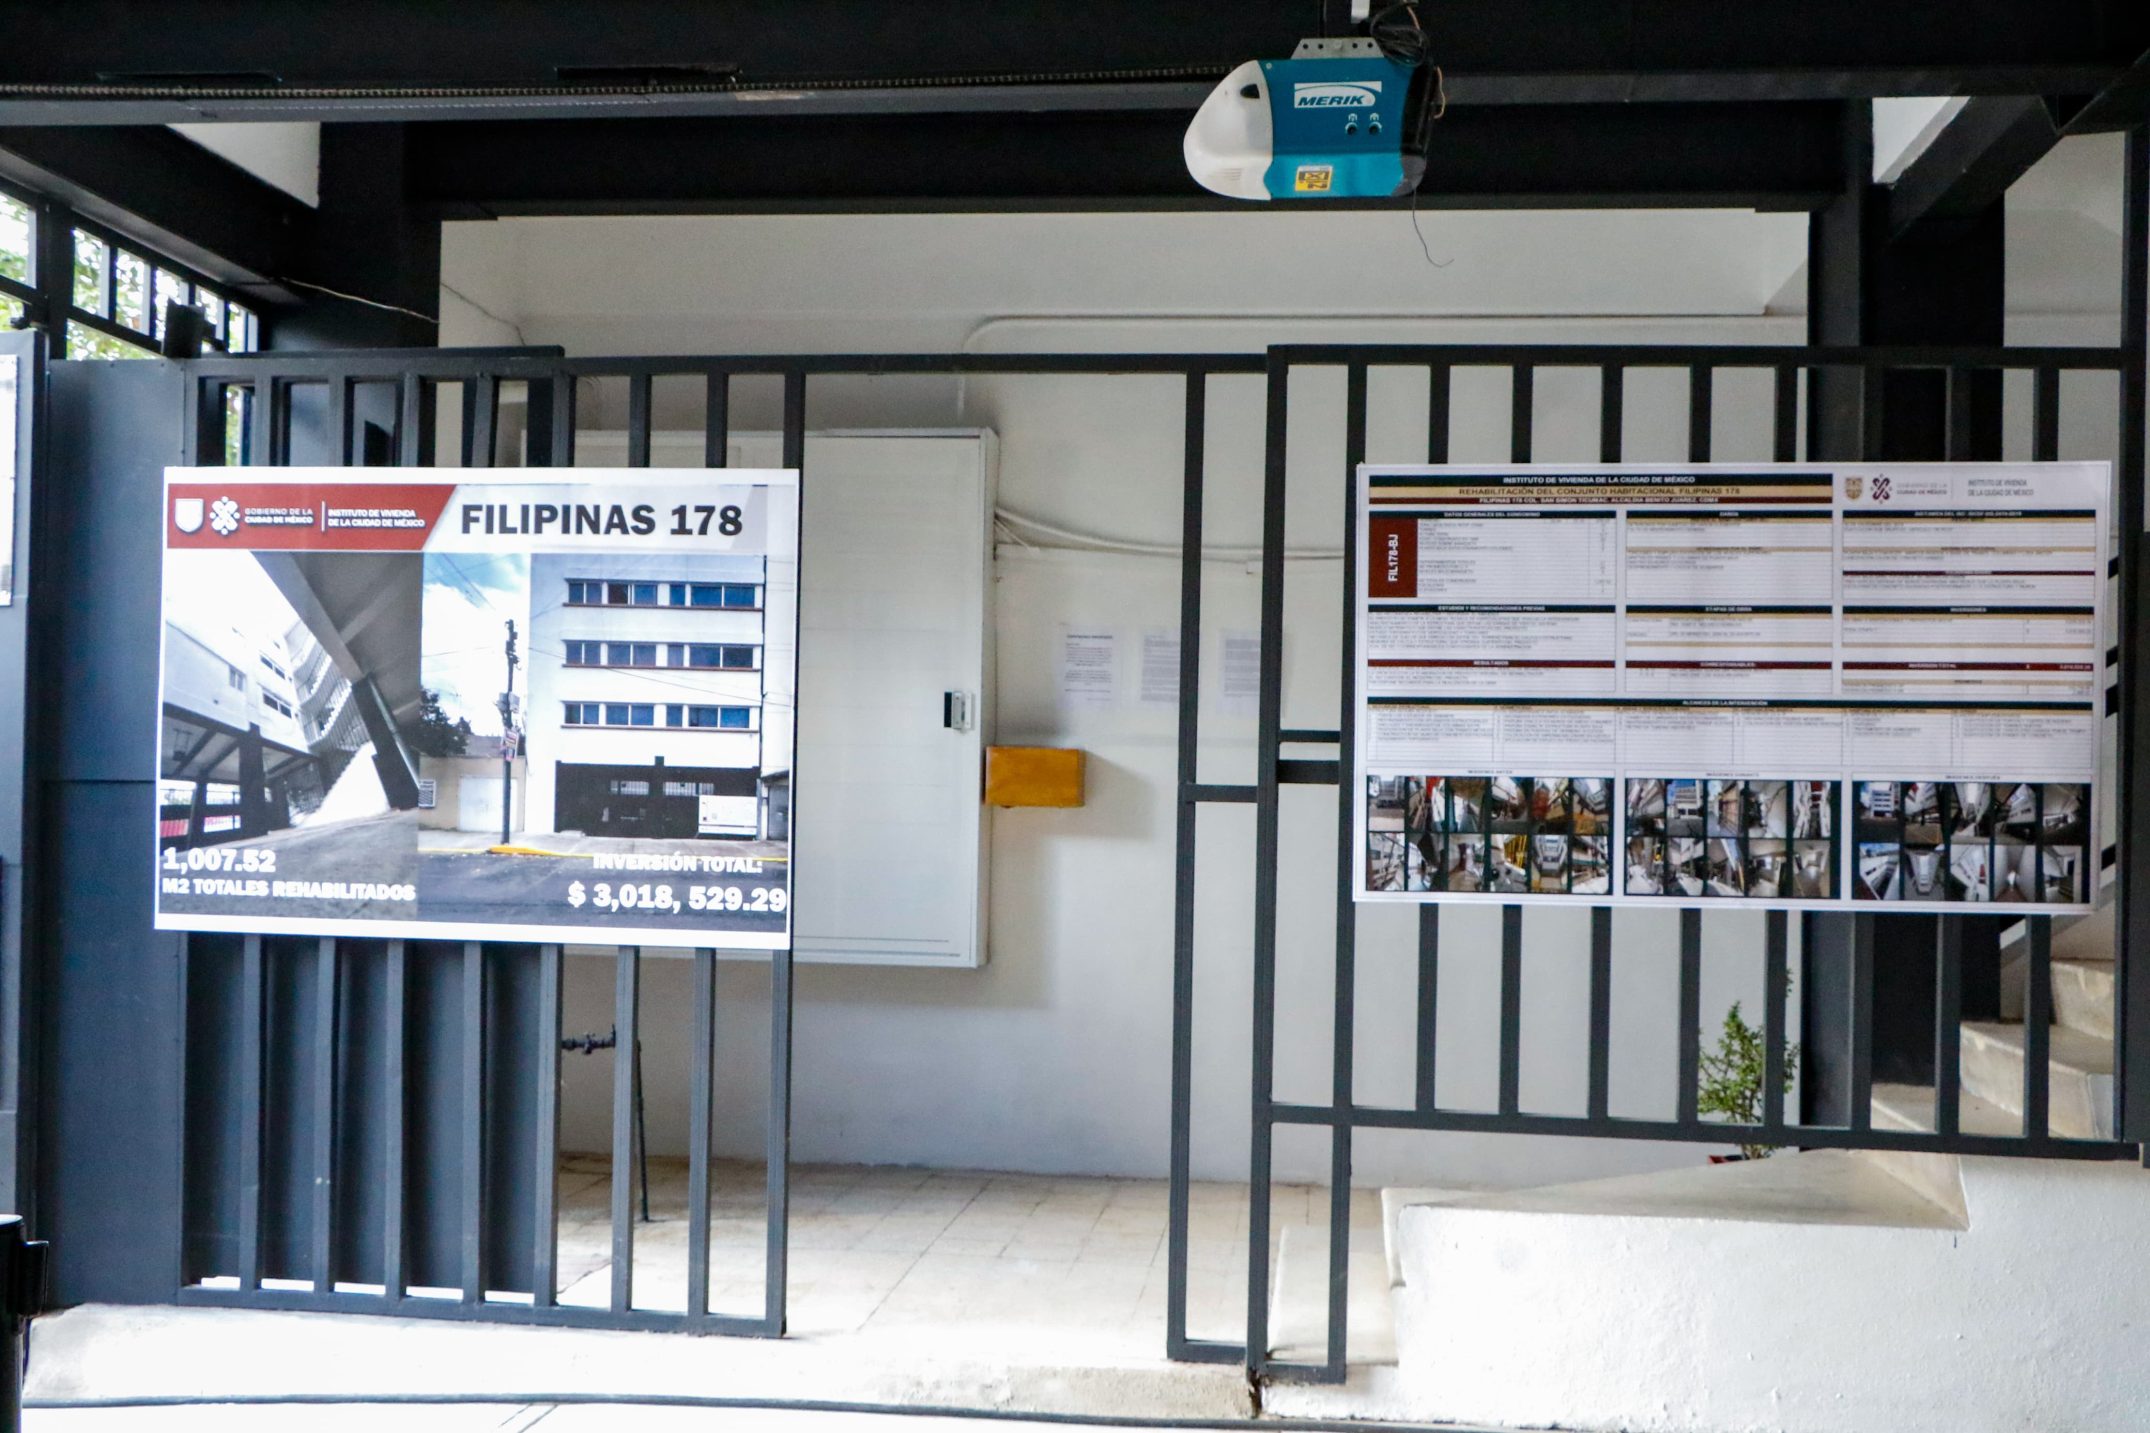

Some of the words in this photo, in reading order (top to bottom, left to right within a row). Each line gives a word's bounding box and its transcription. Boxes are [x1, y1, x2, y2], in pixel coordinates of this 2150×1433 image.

[1297, 95, 1366, 106] MERIK
[1503, 476, 1544, 484] INSTITUTO
[1545, 476, 1557, 484] DE
[1558, 476, 1594, 484] VIVIENDA
[1595, 476, 1607, 484] DE
[1608, 476, 1619, 484] LA
[1664, 475, 1695, 483] MÉXICO
[1459, 486, 1535, 496] REHABILITACIÓN
[1536, 487, 1555, 495] DEL
[1557, 486, 1608, 495] CONJUNTO
[1609, 486, 1676, 495] HABITACIONAL
[1679, 487, 1722, 495] FILIPINAS
[1726, 487, 1741, 495] 178
[244, 508, 288, 516] GOBIERNO
[289, 508, 301, 516] DE
[302, 508, 314, 516] LA
[328, 509, 368, 518] INSTITUTO
[368, 509, 380, 518] DE
[380, 509, 416, 518] VIVIENDA
[244, 516, 272, 524] CIUDAD
[273, 516, 285, 524] DE
[285, 515, 314, 524] MÉXICO
[328, 518, 340, 527] DE
[340, 518, 351, 527] LA
[351, 518, 381, 527] CIUDAD
[381, 519, 393, 528] DE
[393, 518, 426, 528] MÉXICO
[461, 504, 656, 536] FILIPINAS
[669, 504, 743, 536] 178
[1387, 533, 1399, 582] FIL178-BJ
[163, 847, 277, 875] 1,007.52
[593, 851, 697, 872] INVERSIÓN
[699, 856, 763, 874] TOTAL:
[162, 877, 190, 894] M2
[193, 878, 269, 897] TOTALES
[272, 880, 416, 901] REHABILITADOS
[568, 880, 587, 908] $
[593, 883, 681, 914] 3,018,
[688, 885, 787, 912] 529.29
